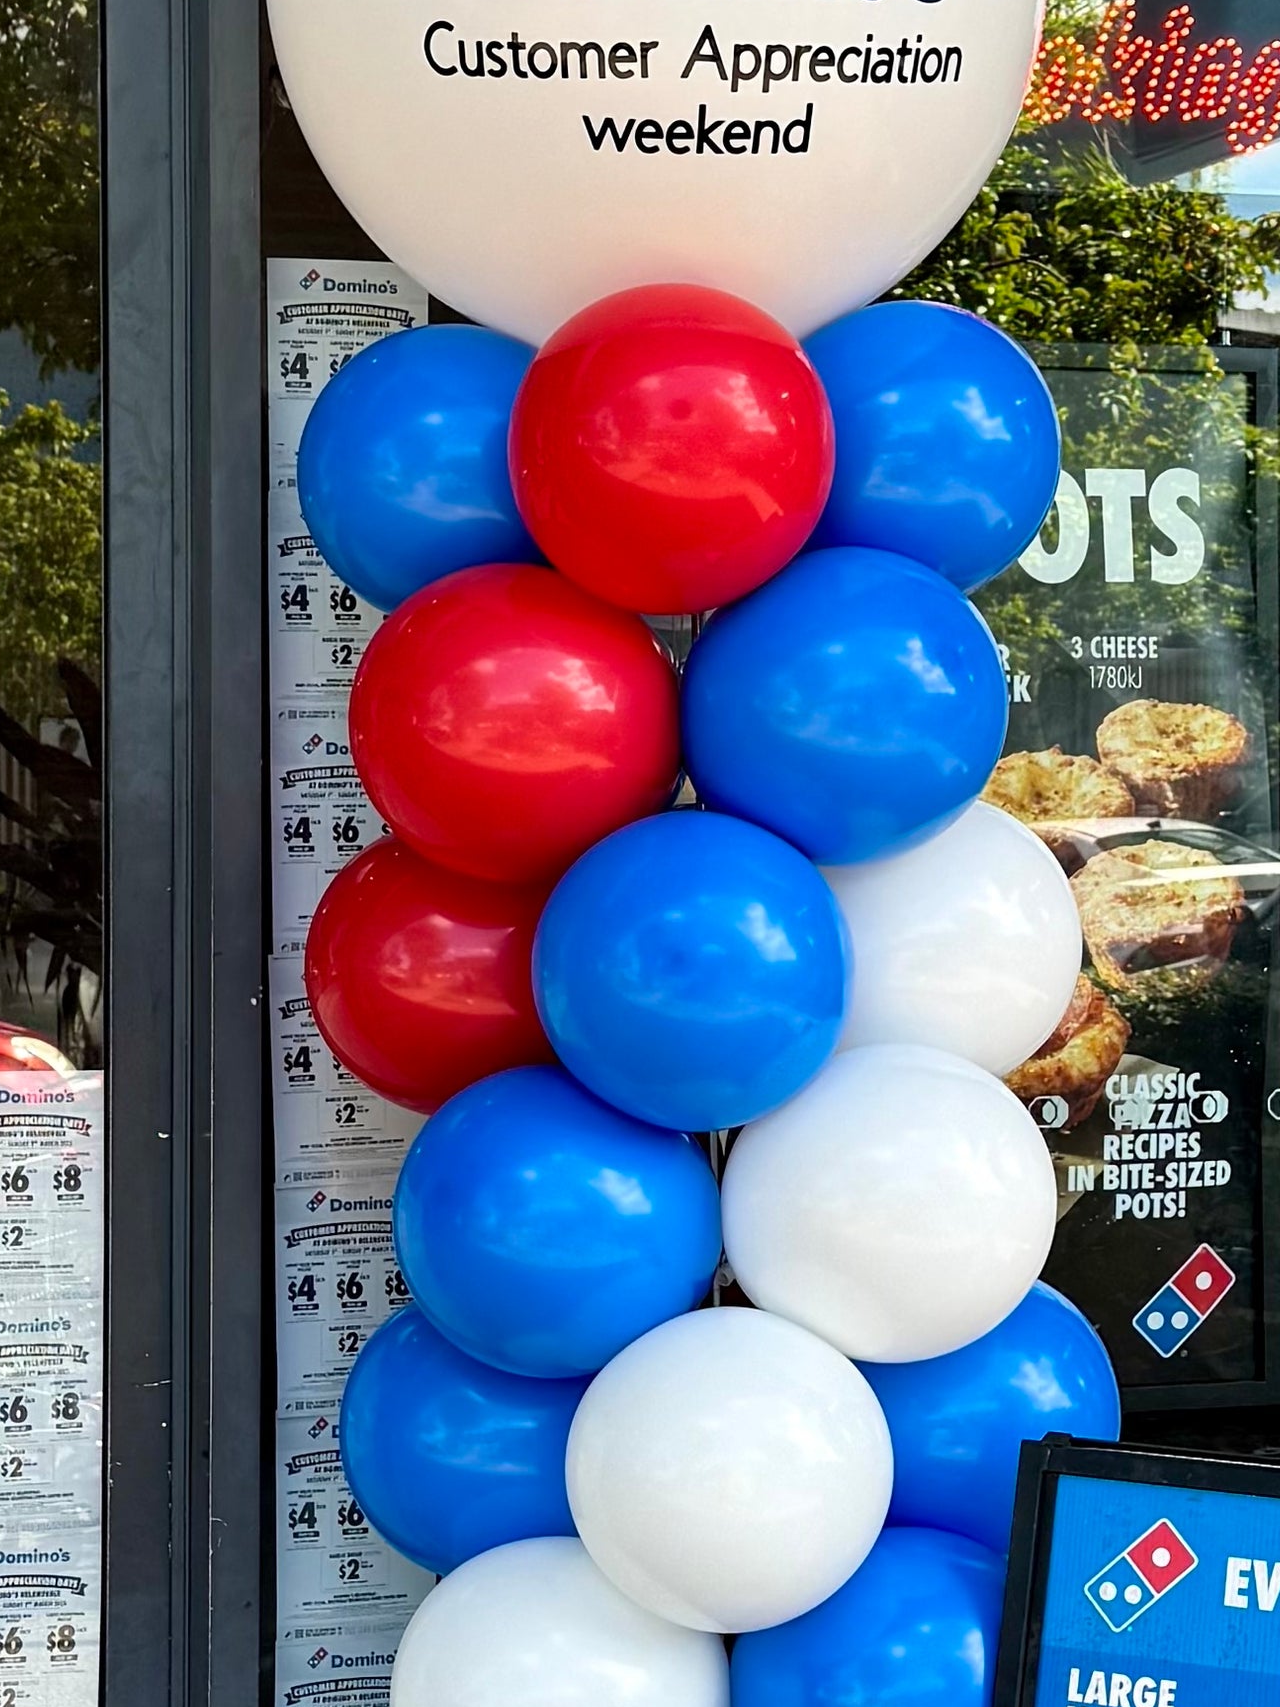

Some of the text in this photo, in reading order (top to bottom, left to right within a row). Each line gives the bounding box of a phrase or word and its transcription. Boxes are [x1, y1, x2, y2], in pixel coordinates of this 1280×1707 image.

[422, 20, 963, 93] Customer Appreciation
[582, 103, 814, 155] weekend
[323, 278, 399, 295] Domino's
[279, 352, 309, 380] $4
[1071, 636, 1159, 659] 3 CHEESE
[1089, 665, 1143, 689] 1780kJ
[1105, 1072, 1201, 1101] CLASSIC
[1103, 1132, 1201, 1161] RECIPES
[1067, 1160, 1232, 1191] IN BITE-SIZED
[1115, 1191, 1187, 1220] POTS!
